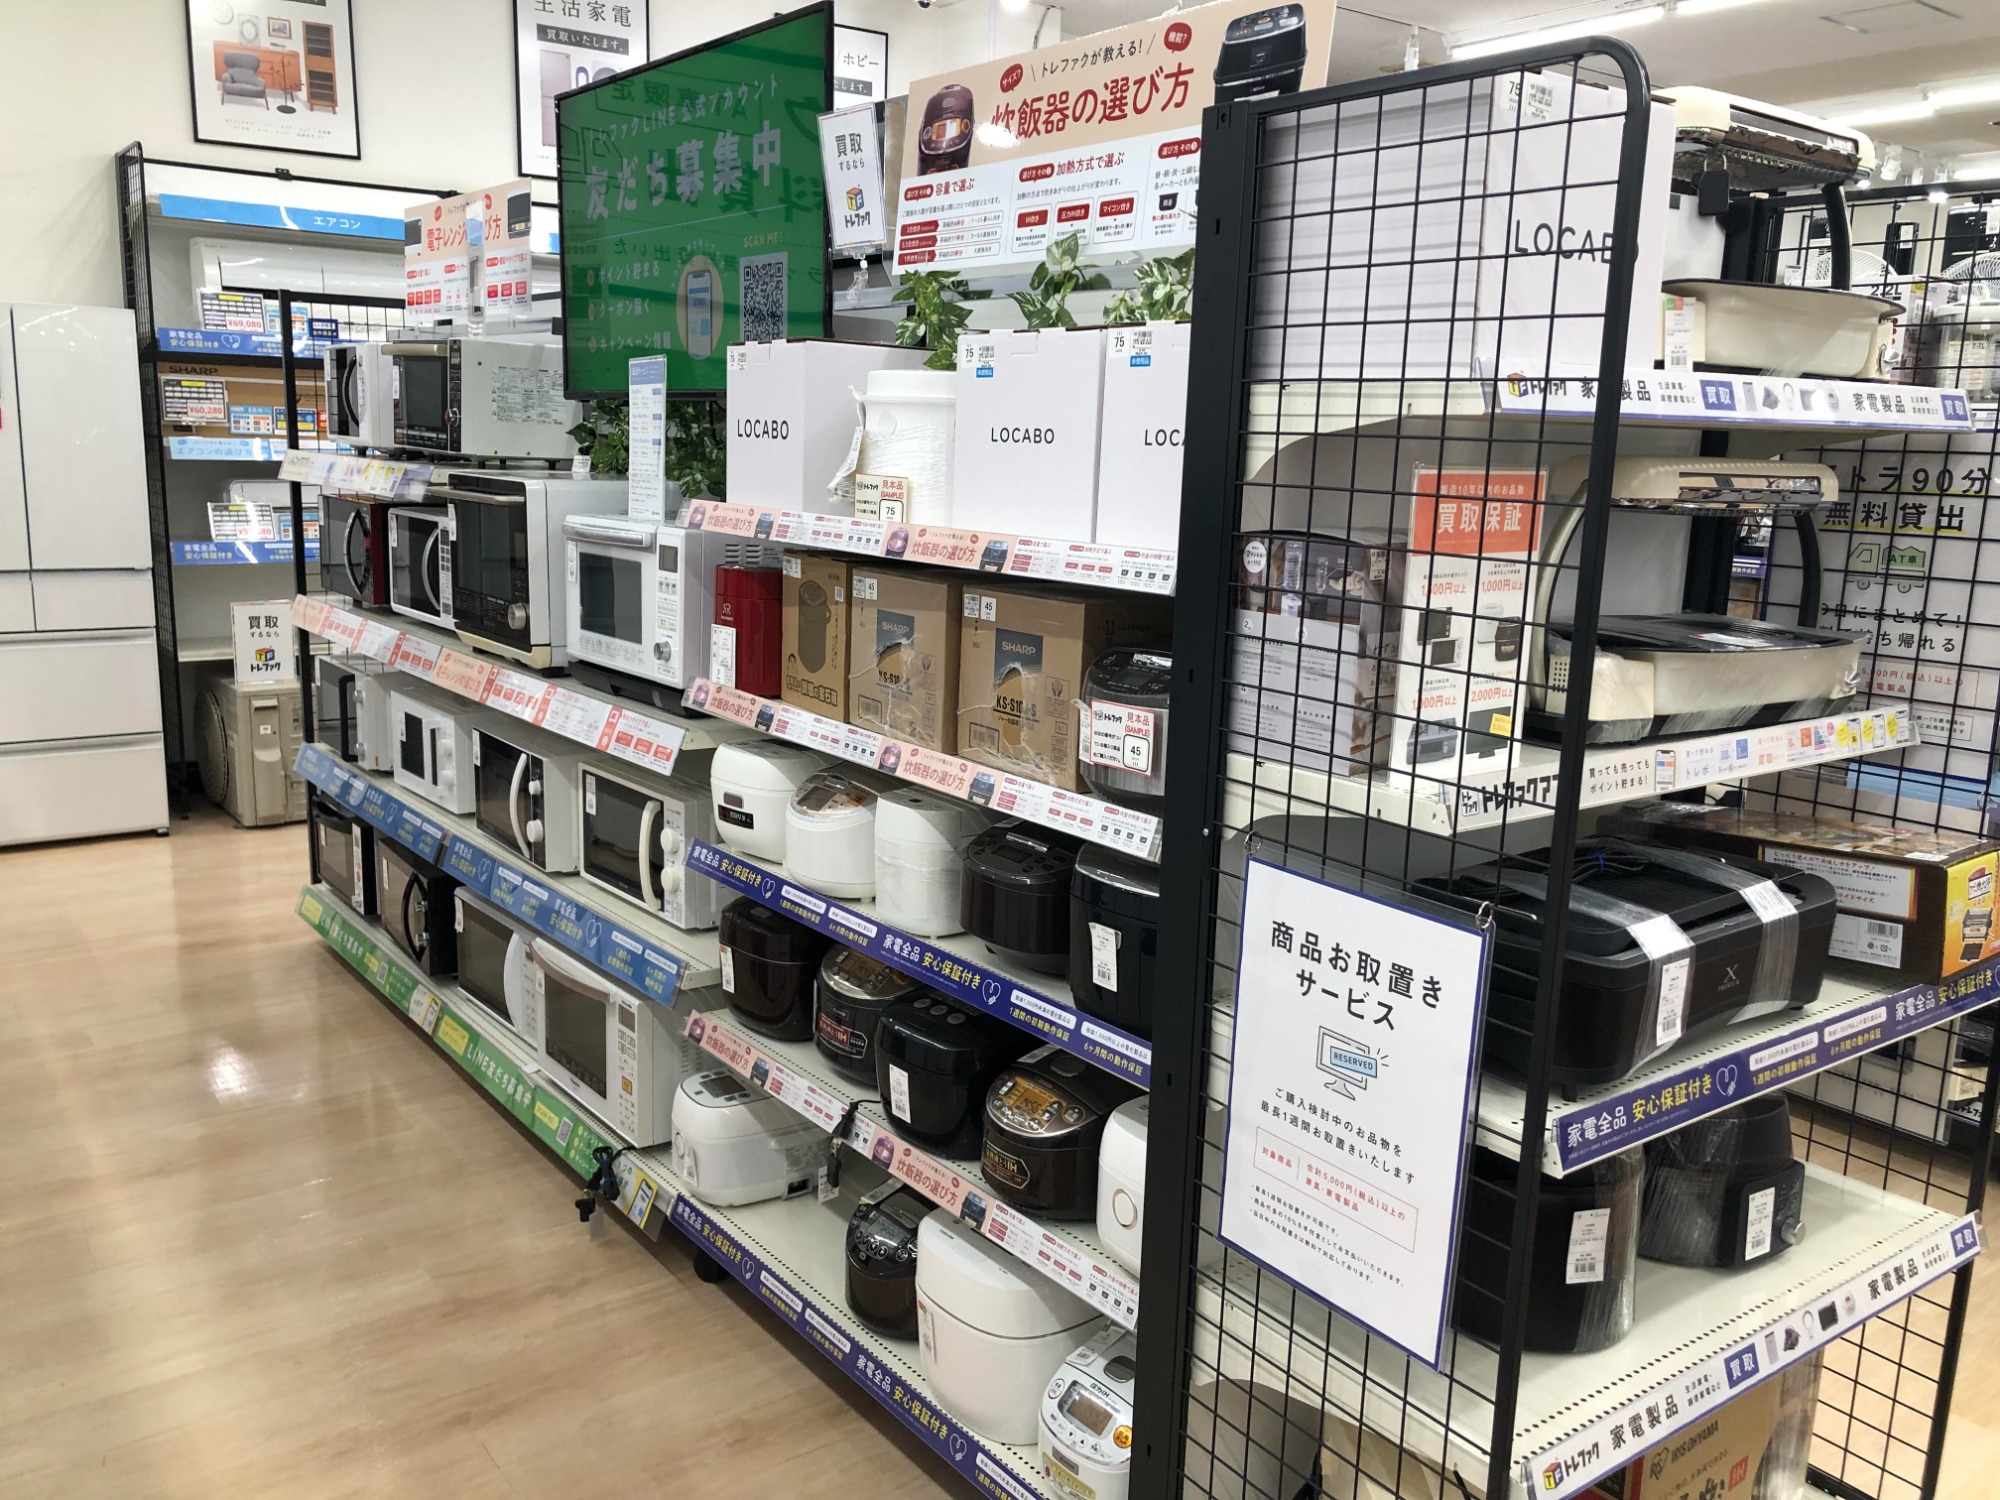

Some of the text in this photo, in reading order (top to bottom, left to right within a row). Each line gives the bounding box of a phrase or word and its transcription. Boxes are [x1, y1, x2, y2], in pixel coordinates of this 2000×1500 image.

[546, 28, 623, 51] 買取いたします。
[991, 63, 1195, 139] 炊飯器の選び方
[835, 133, 863, 158] 買取
[586, 120, 781, 221] 友だち募集中
[1056, 152, 1125, 176] 加熱方式で選ぶ
[935, 178, 975, 196] 容量で選ぶ
[314, 216, 361, 229] エアコン
[845, 211, 871, 228] トレファク
[744, 235, 765, 248] SCAN
[228, 318, 262, 329] ¥69,080
[1114, 337, 1125, 347] 75
[169, 365, 218, 375] SHARP
[1705, 386, 1731, 405] 買取
[1853, 393, 1906, 413] 家電製品
[189, 406, 222, 414] ¥60,280
[737, 419, 789, 440] LOCABO
[991, 427, 1055, 444] LOCABO
[882, 480, 903, 490] 見本品
[886, 507, 895, 515] 75
[1437, 502, 1521, 534] 買取保証
[1824, 501, 1964, 532] 無料貸出
[708, 515, 753, 532] 炊飯器の選び方
[912, 542, 977, 563] 炊飯器の選び方
[1482, 579, 1523, 592] 1,000円以上
[249, 616, 279, 630] 買取
[882, 621, 909, 634] SHARP
[1002, 641, 1036, 655] SHARP
[710, 697, 754, 721] 炊飯器の選び方
[1127, 712, 1149, 726] 見本品
[1125, 724, 1150, 738] (SAMPLE)
[1131, 746, 1141, 756] 45
[904, 760, 966, 790] 炊飯器の選び方
[1588, 759, 1650, 779] 買っても売っても
[1590, 776, 1649, 794] ポイント貯まる!
[692, 846, 762, 887] 家電全品 安心保証付き
[882, 934, 980, 989] 家電全品 安心保証付き
[1272, 920, 1442, 1009] 商品お取置き
[1296, 969, 1395, 1031] サービス
[1895, 968, 1993, 1021] 家電全品 安心保証付き
[705, 1035, 750, 1071] 炊飯器の選び方
[1333, 1051, 1373, 1071] RESERVED
[466, 1043, 532, 1108] LINE友だち募集中
[1275, 1087, 1403, 1158] ご購入検討中のお品物を
[1568, 1073, 1713, 1149] 家電全品 安心保証付き
[1260, 1100, 1415, 1185] 最長1週間お取置きいたします
[1262, 1146, 1293, 1169] 対象商品
[896, 1160, 959, 1206] 炊飯器の選び方
[1305, 1177, 1360, 1213] 家具・家電製品
[677, 1202, 742, 1263] 家電全品 安心保証付き
[1954, 1227, 1974, 1253] 買取
[1868, 1257, 1919, 1300] 家電製品
[1730, 1352, 1756, 1380] 買取
[856, 1355, 949, 1440] 家電全品 安心保証付き
[1565, 1394, 1680, 1478] トレファク 家電製品
